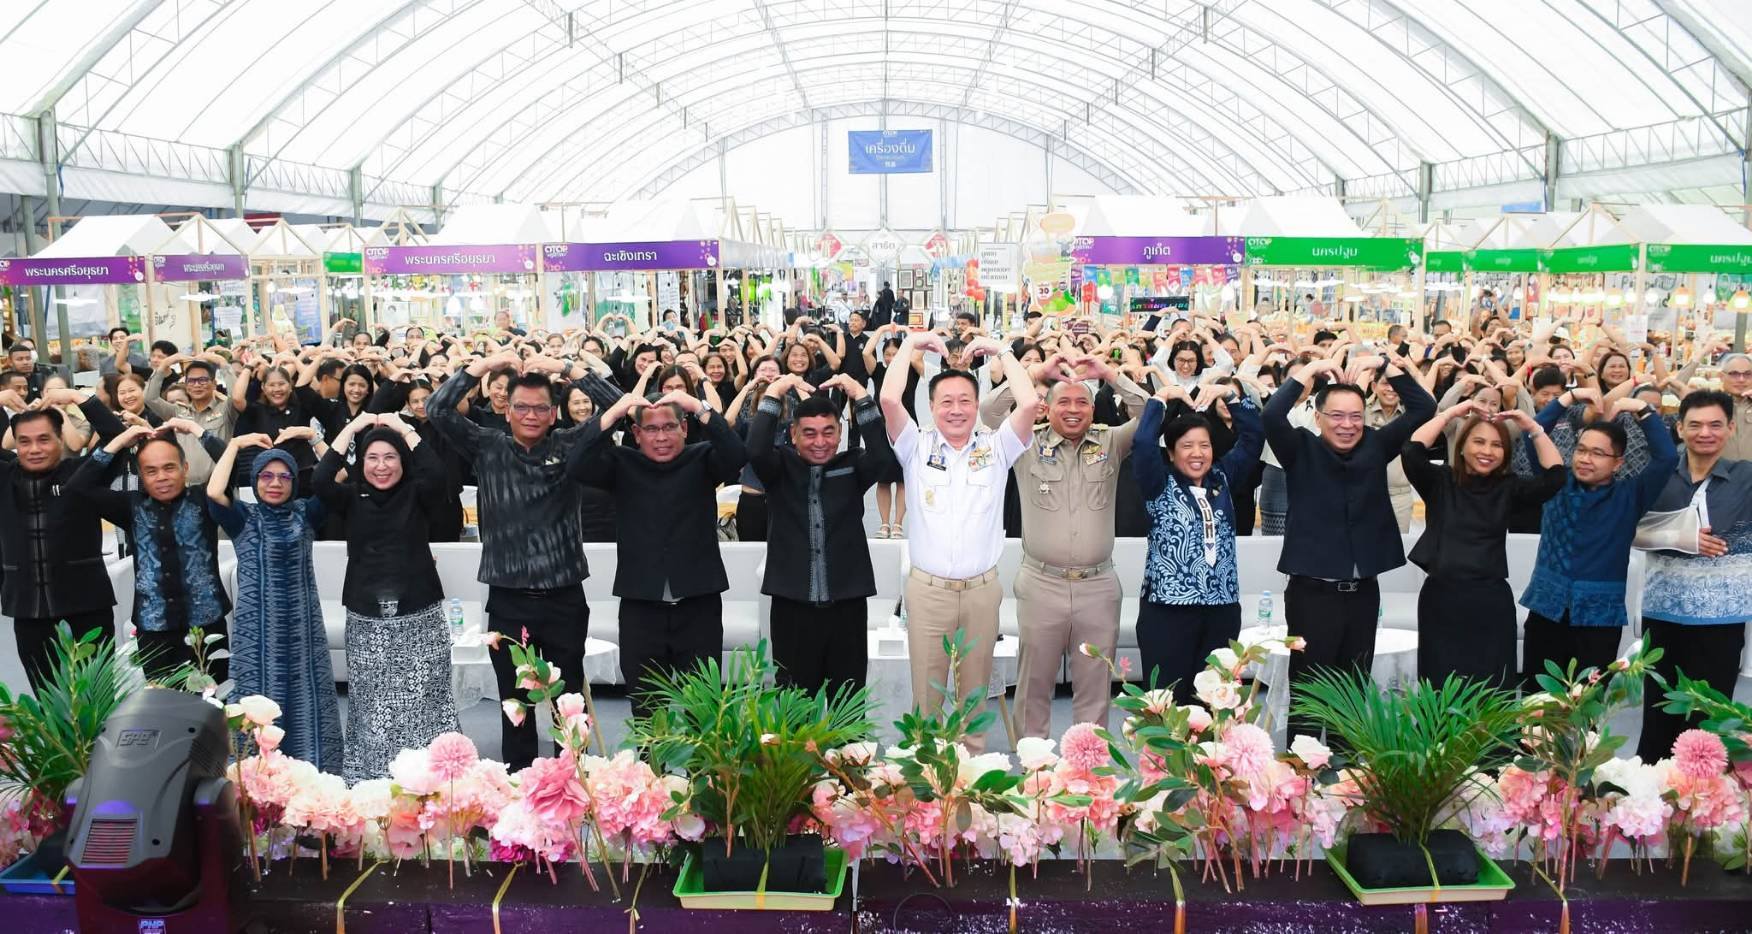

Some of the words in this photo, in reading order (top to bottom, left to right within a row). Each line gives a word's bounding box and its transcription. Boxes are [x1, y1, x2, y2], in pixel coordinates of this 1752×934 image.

[865, 136, 916, 154] เครื่องดื่ม
[366, 248, 390, 256] OTOP
[544, 245, 569, 254] OTOP
[603, 250, 658, 262] ฉะเชิงเทรา
[1143, 242, 1171, 260] ภูเก็ต
[1312, 244, 1358, 259] นครปฐม
[404, 252, 496, 267] พระนครศรีอยุธยา
[25, 264, 109, 279] พระนครศรีอยุธยา
